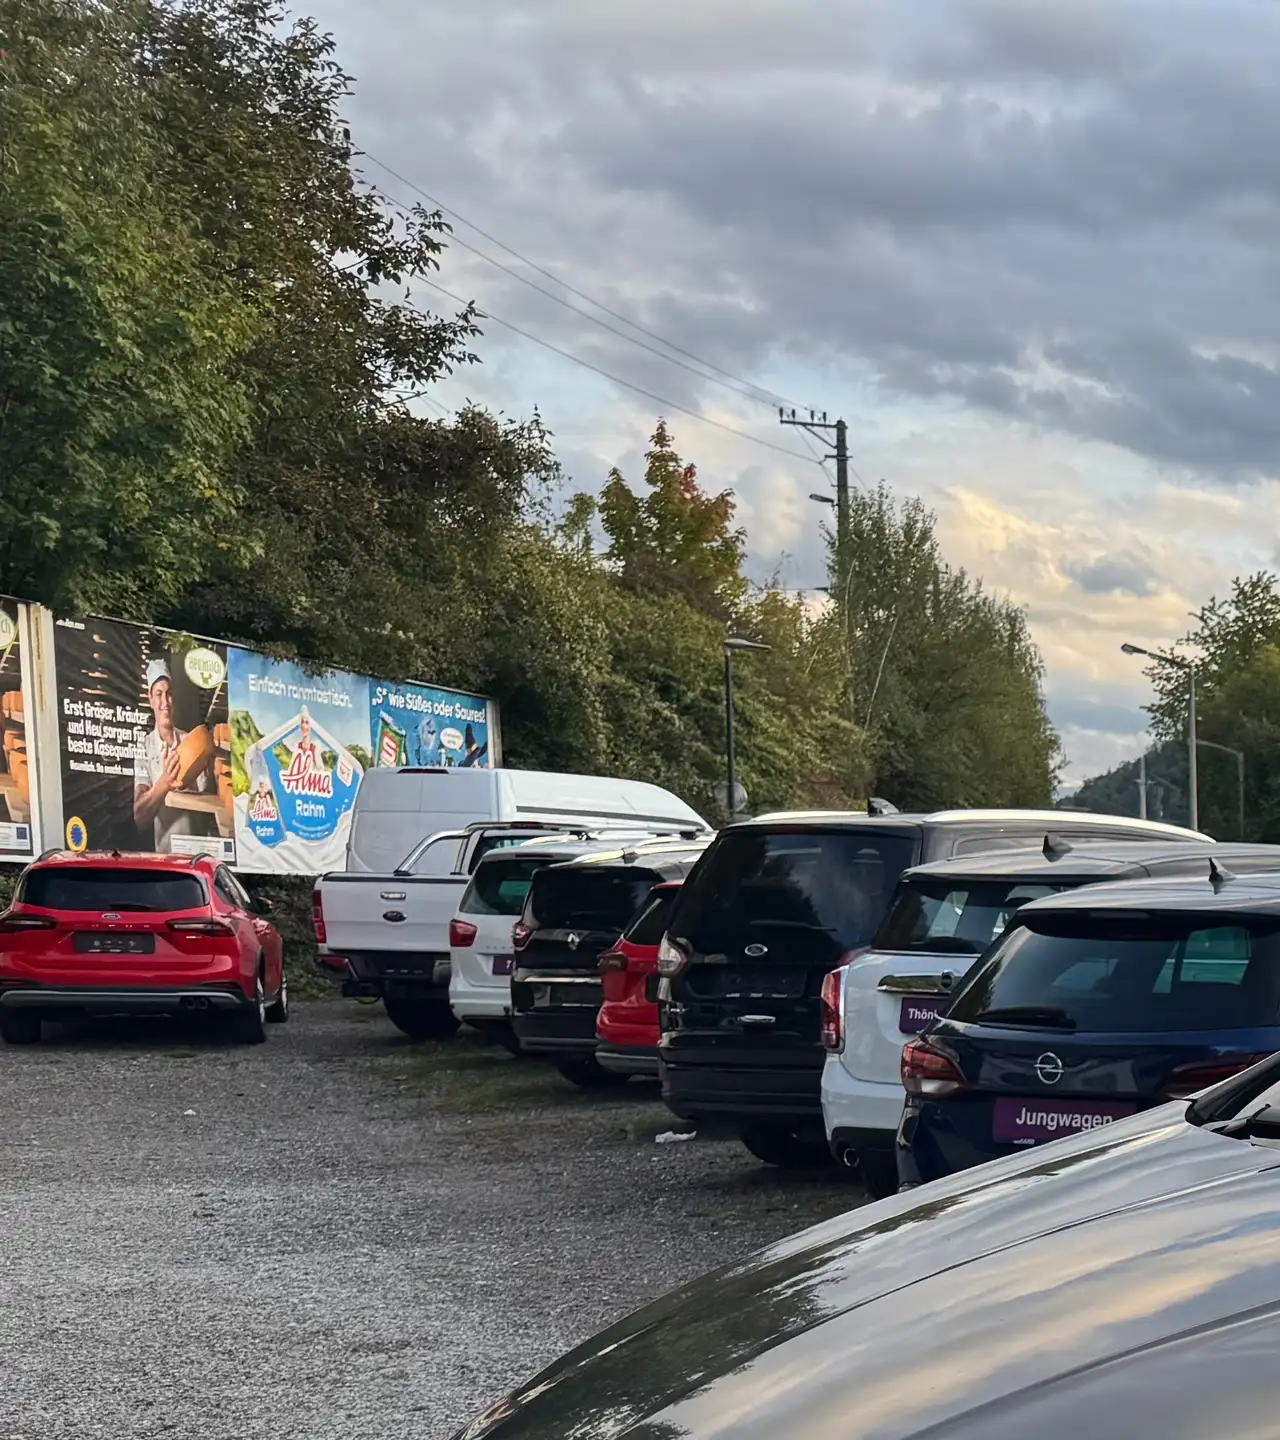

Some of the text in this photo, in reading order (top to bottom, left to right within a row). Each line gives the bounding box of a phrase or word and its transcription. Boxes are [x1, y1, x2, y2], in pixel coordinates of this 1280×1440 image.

[248, 673, 353, 709] Einfach rahmtastisch.
[63, 698, 151, 725] Erst Gräser, Kräuter
[388, 693, 404, 708] wie
[405, 693, 433, 714] Süßes
[433, 700, 454, 718] oder
[455, 703, 486, 724] Saures!
[68, 719, 147, 743] und Heu sorgen für
[68, 735, 93, 755] beste
[282, 750, 333, 795] Alma
[295, 799, 325, 819] Rahm
[1015, 1107, 1113, 1131] Jungwagen
